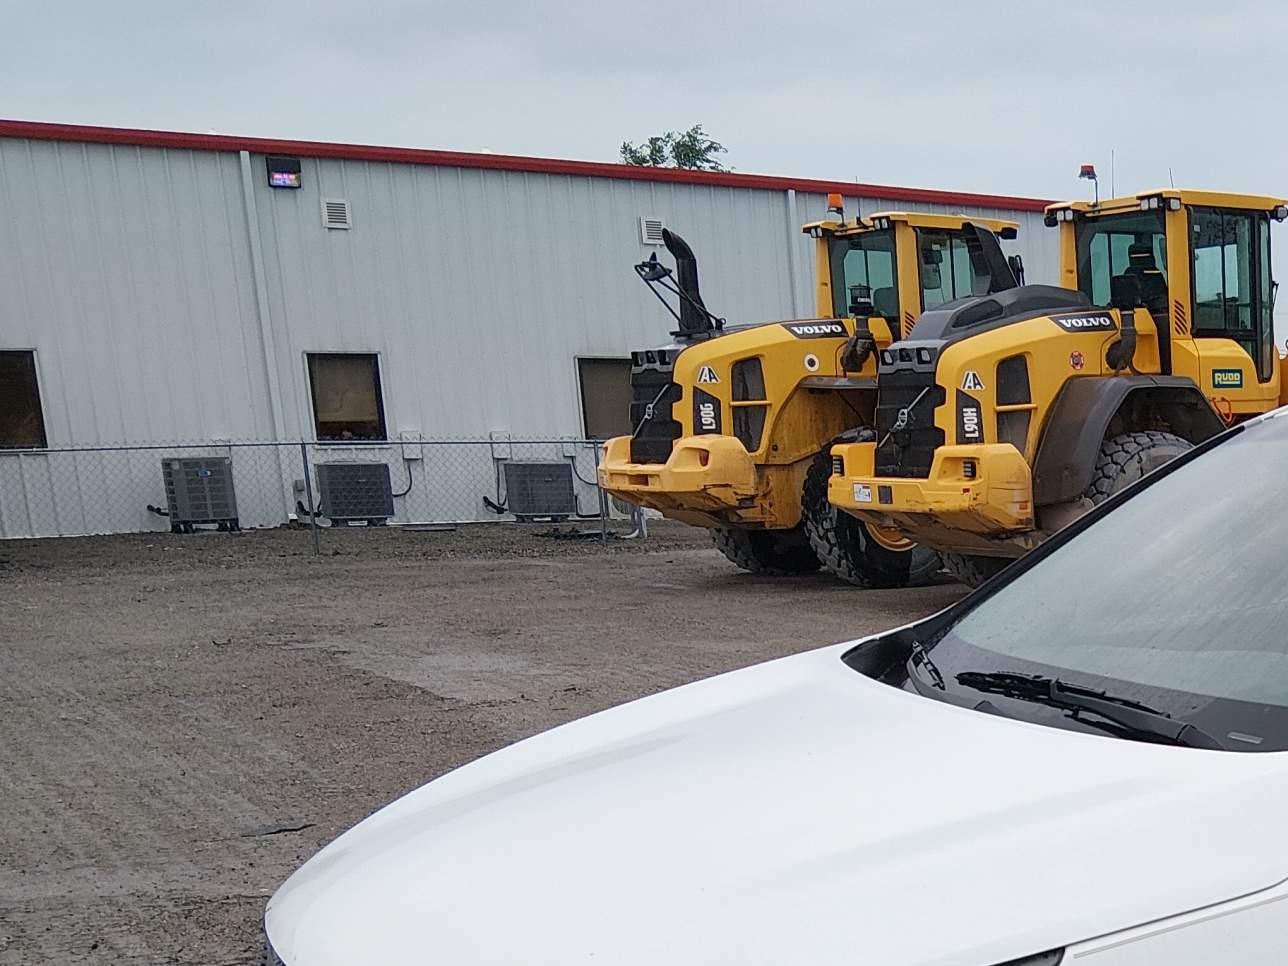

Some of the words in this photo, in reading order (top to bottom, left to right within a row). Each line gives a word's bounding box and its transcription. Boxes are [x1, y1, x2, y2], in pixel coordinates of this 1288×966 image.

[791, 324, 843, 335] VOLVO
[1058, 316, 1111, 328] VOLVO
[700, 403, 717, 430] L90G
[962, 407, 980, 438] L90H
